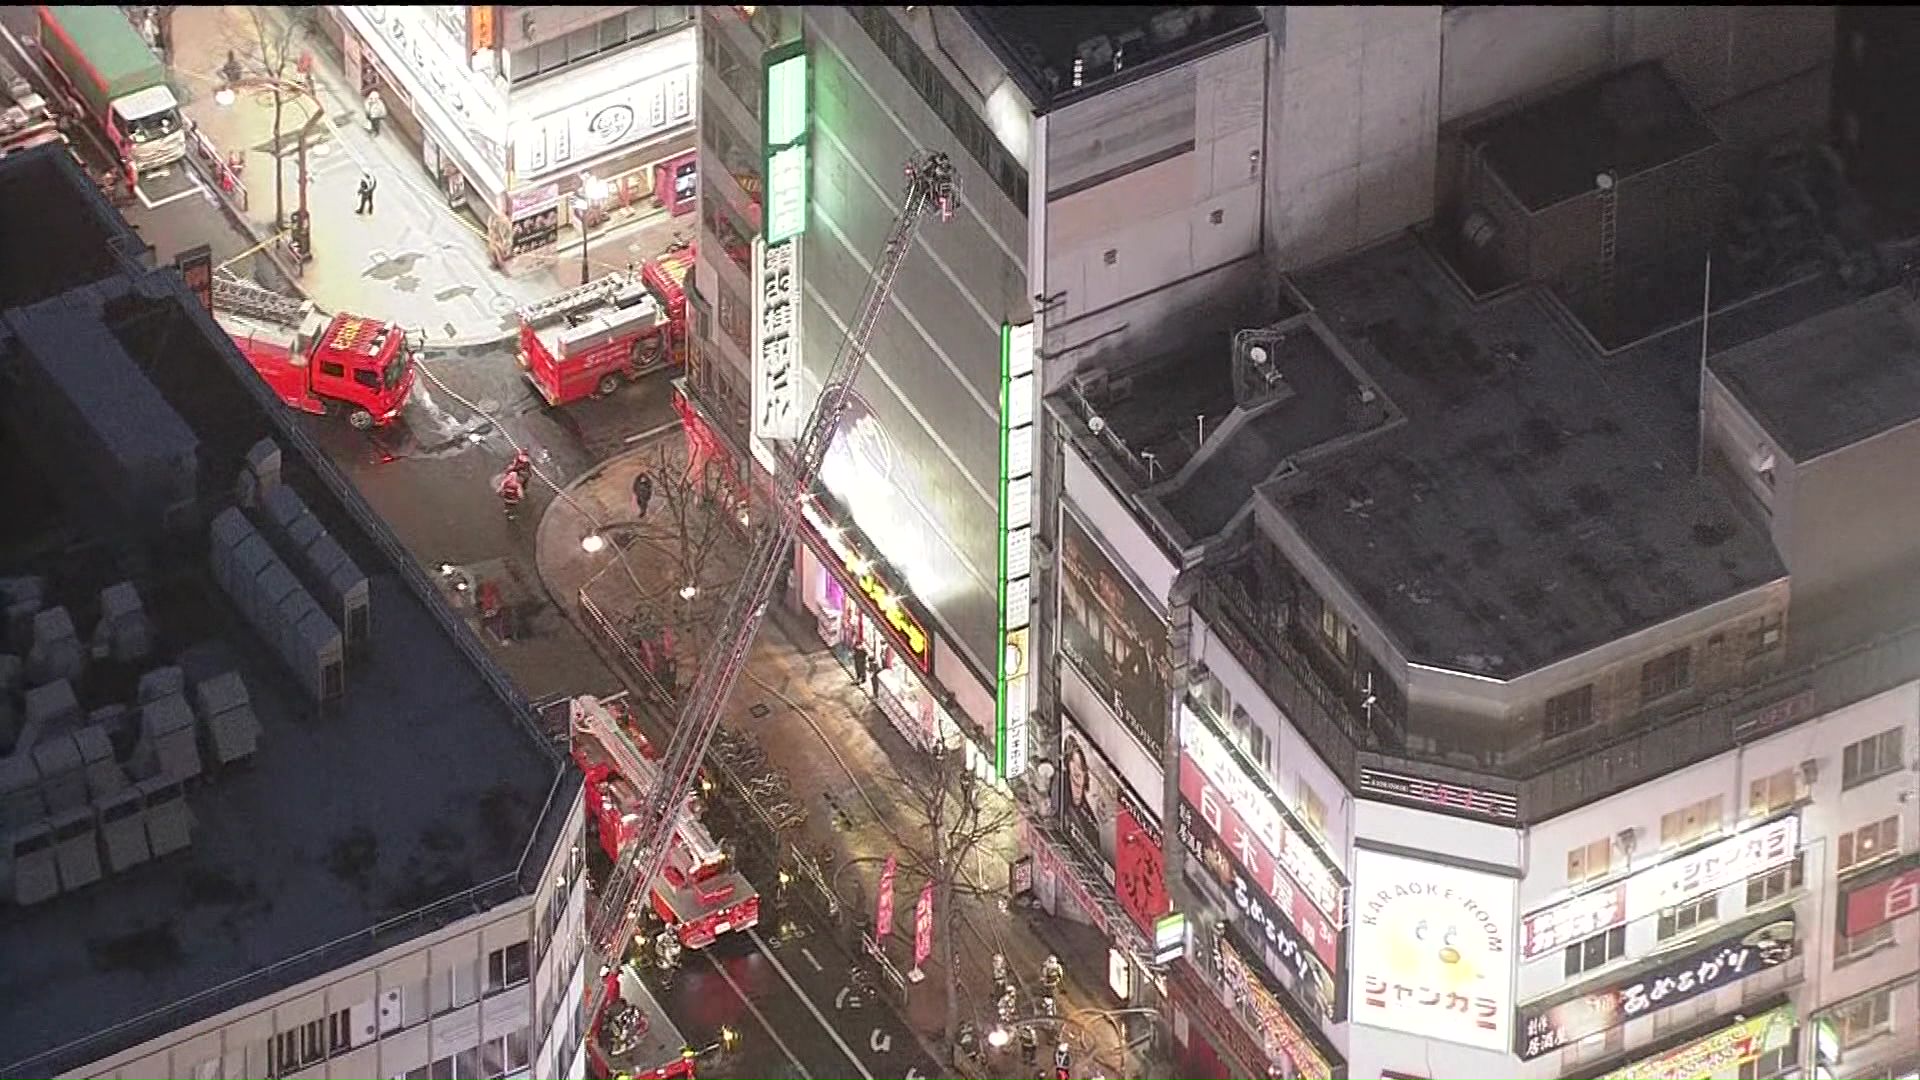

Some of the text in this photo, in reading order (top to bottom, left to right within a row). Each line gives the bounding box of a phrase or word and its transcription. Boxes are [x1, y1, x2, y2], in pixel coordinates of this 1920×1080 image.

[1201, 785, 1296, 923] 白木屋
[1233, 875, 1308, 979] あめあがり
[1622, 948, 1749, 1014] あめあがり
